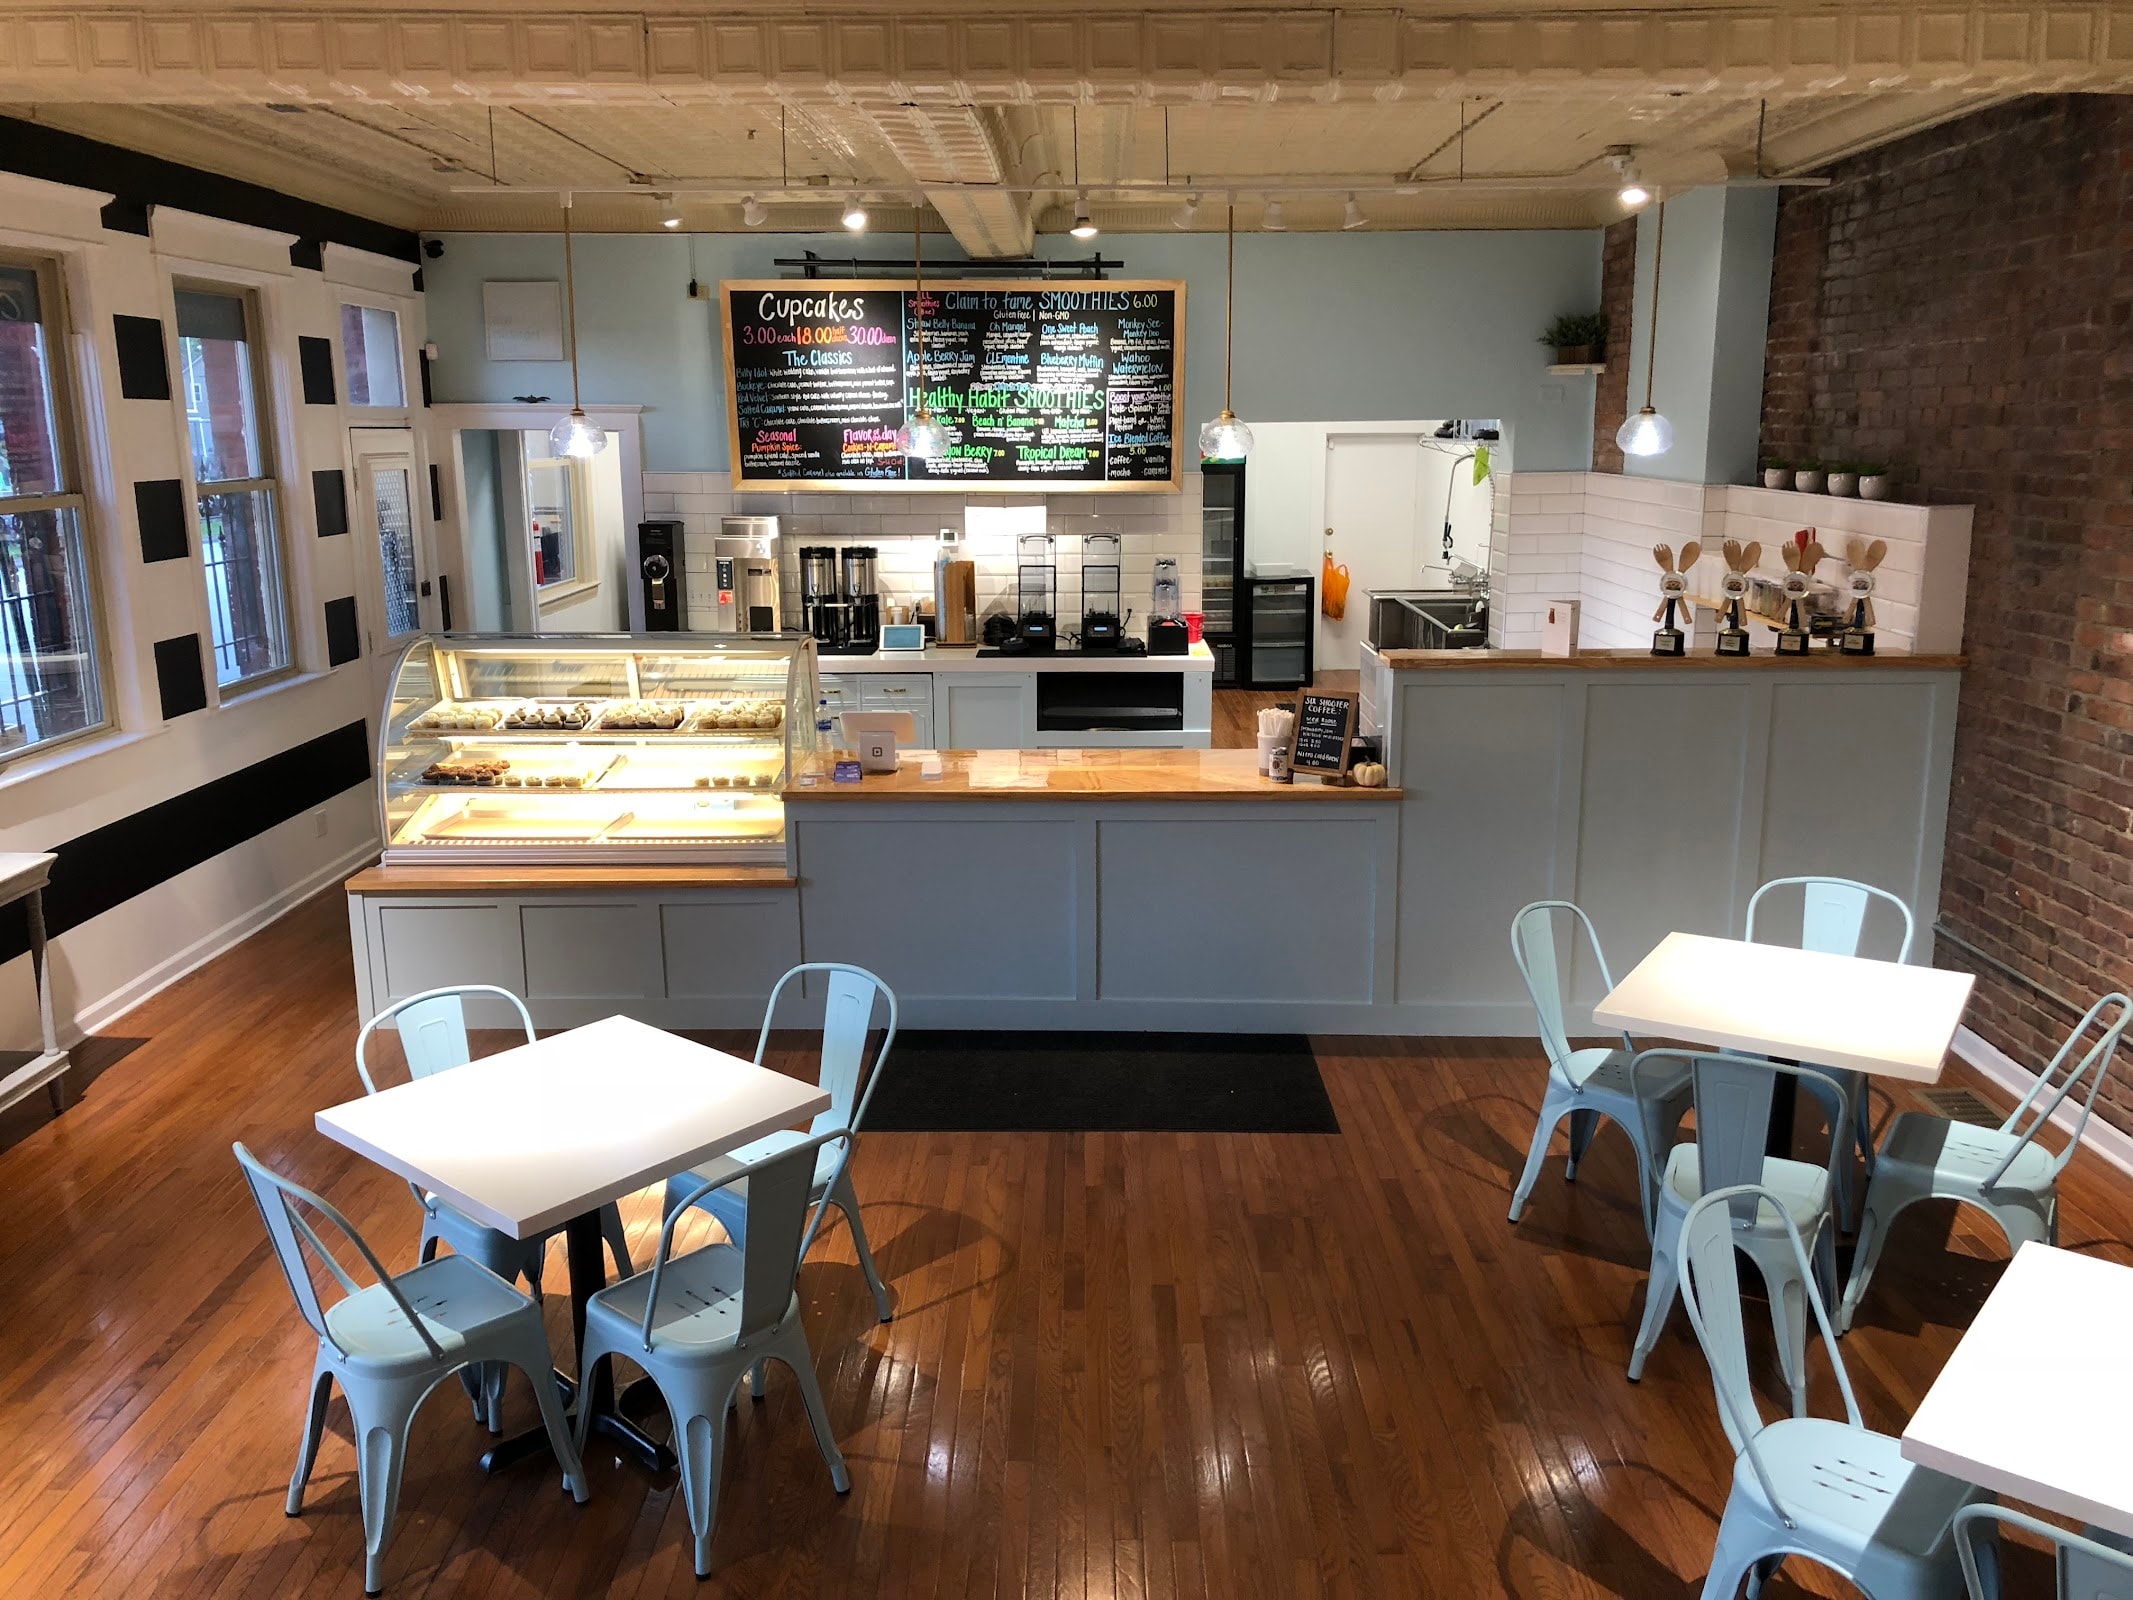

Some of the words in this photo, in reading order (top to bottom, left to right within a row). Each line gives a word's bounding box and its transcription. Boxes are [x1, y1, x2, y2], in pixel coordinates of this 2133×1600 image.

[945, 291, 979, 310] Claim
[981, 291, 997, 310] to
[1003, 291, 1033, 310] fame
[1039, 291, 1130, 310] SMOOTHIES
[1133, 294, 1158, 308] 6.00
[759, 291, 865, 327] Cupcakes
[1039, 311, 1070, 320] Non-GMO
[1042, 324, 1056, 334] One
[1057, 322, 1077, 334] Sweet
[1079, 322, 1099, 334] Peach
[1118, 318, 1145, 330] Monkey
[744, 325, 777, 344] 3.00
[777, 332, 796, 343] each
[797, 325, 832, 345] 18.00
[848, 325, 882, 345] 30.00
[1123, 330, 1147, 340] Monkey
[782, 349, 809, 366] The
[811, 349, 853, 366] Classics
[960, 350, 975, 363] Jam
[1079, 353, 1104, 368] Muffin
[1121, 351, 1150, 363] Wahoo
[909, 385, 964, 414] Healthy
[969, 387, 1011, 408] Habit
[1014, 389, 1105, 410] SMOOTHIES
[972, 413, 995, 427] Beach
[1006, 414, 1034, 427] Banana
[1054, 414, 1085, 430] Matcha
[756, 428, 797, 443] Seasonal
[844, 428, 873, 444] Flavor
[1108, 433, 1122, 444] Ice
[1124, 432, 1148, 444] Blended
[752, 442, 781, 453] Pumpkin
[1129, 447, 1147, 455] 5.00
[1305, 697, 1316, 705] SIX
[1319, 698, 1349, 709] SHOOTER
